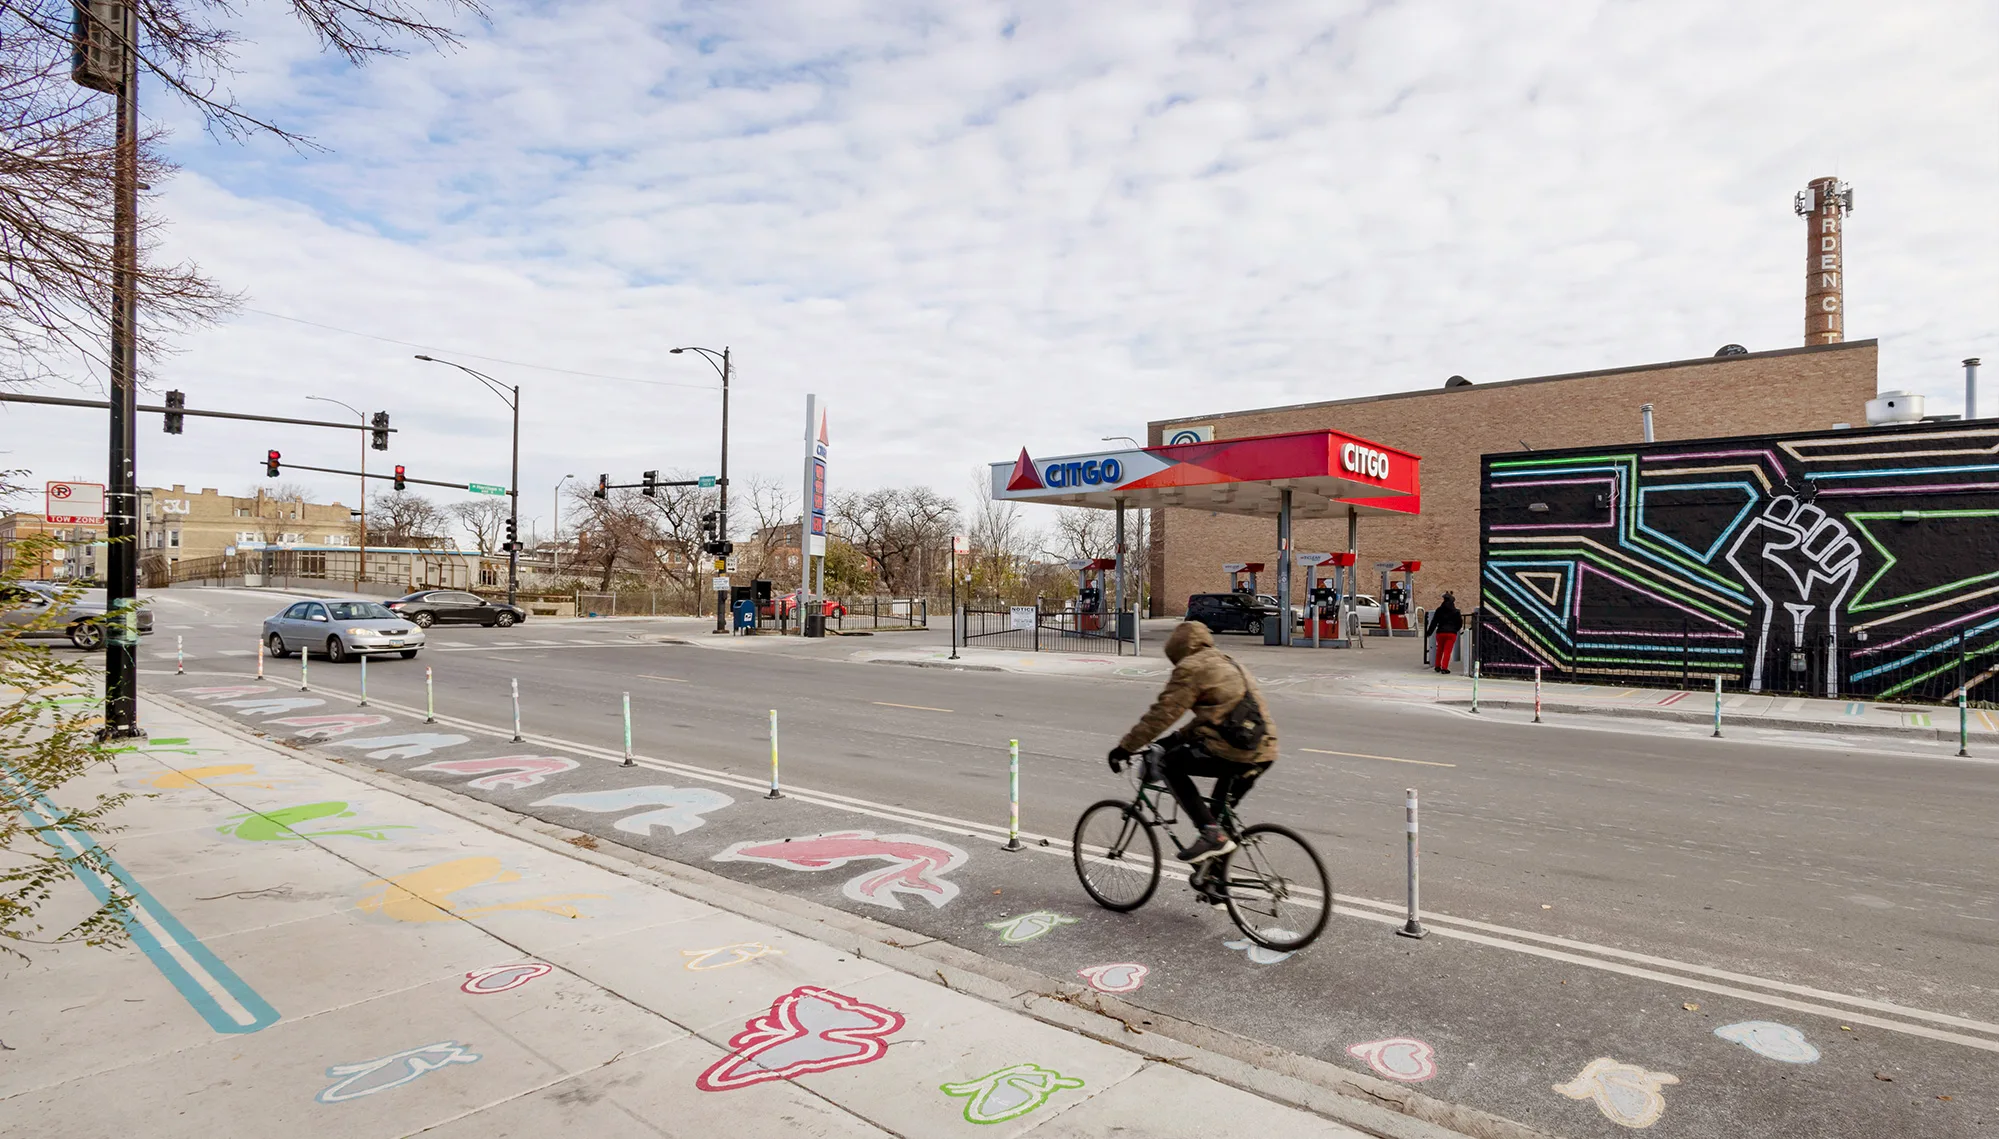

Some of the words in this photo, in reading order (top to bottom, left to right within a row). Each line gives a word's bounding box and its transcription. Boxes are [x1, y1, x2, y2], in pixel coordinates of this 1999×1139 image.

[1045, 458, 1121, 487] CITGO
[1342, 442, 1389, 480] CITGO
[75, 516, 102, 524] ZONE
